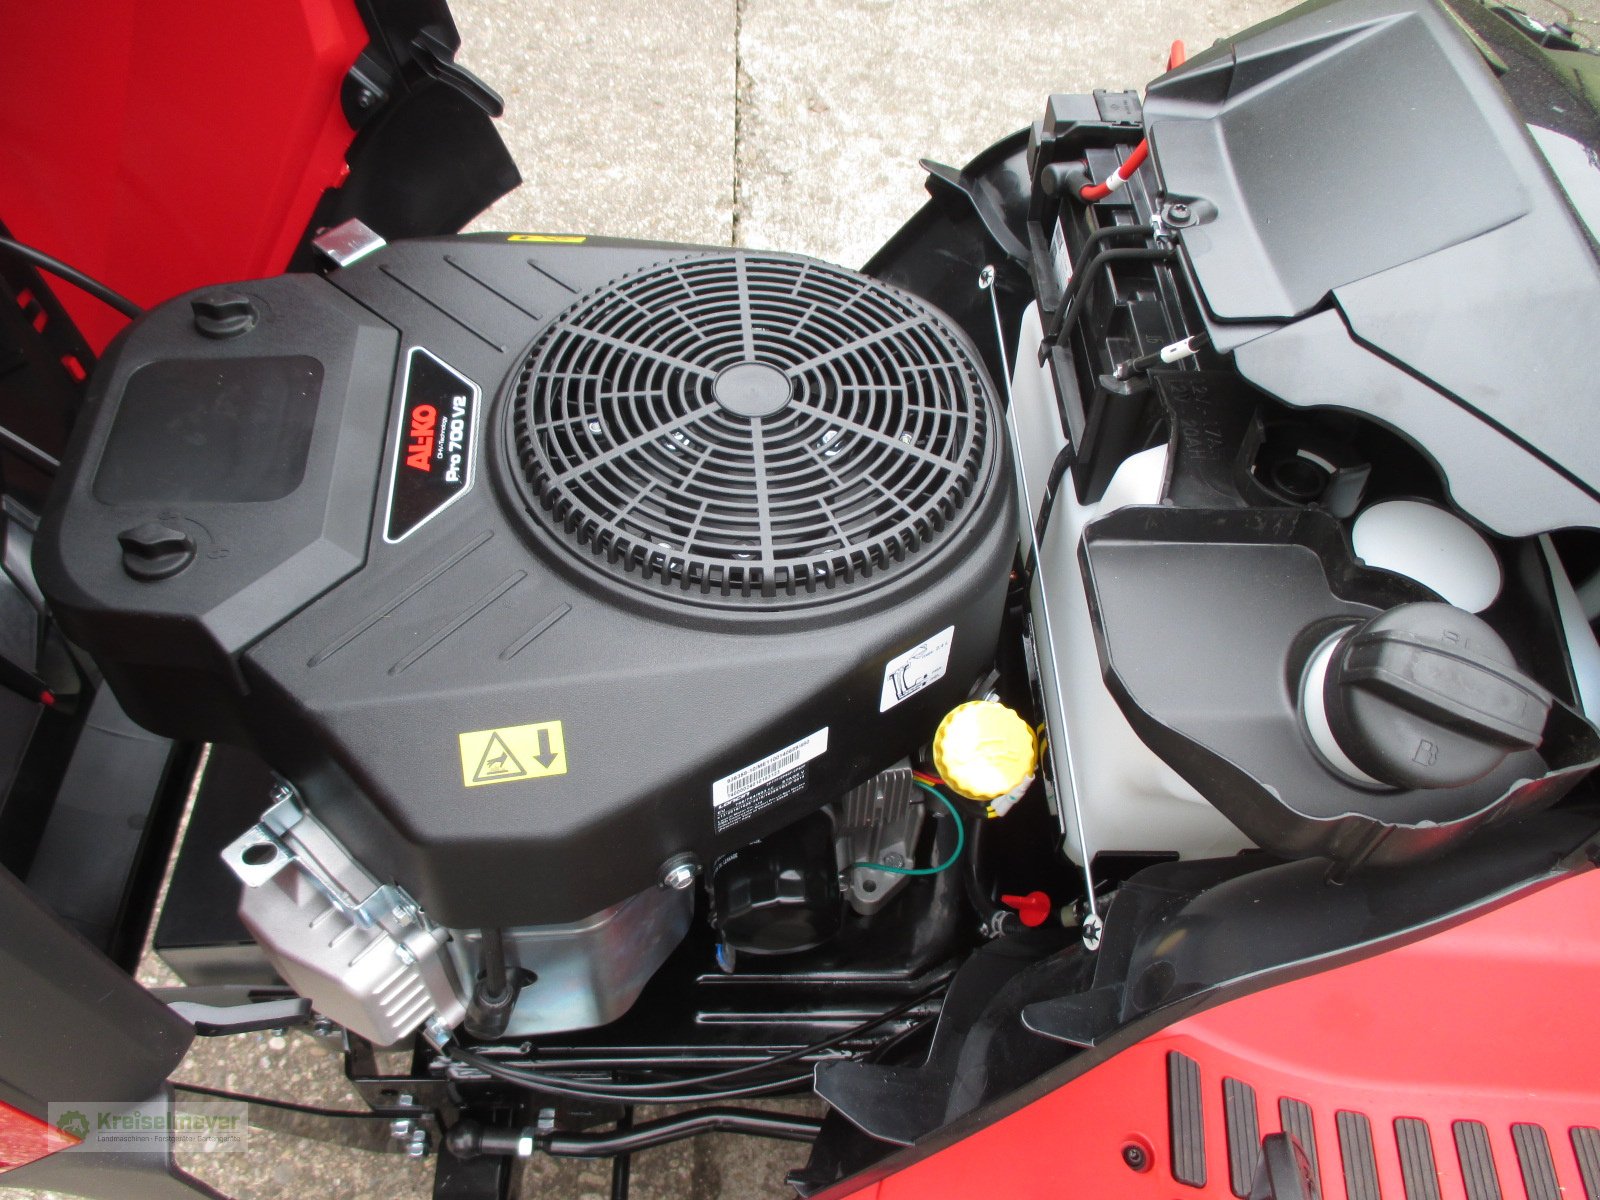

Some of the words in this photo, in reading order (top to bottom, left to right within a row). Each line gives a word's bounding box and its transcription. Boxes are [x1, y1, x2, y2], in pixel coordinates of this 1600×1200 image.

[452, 395, 467, 418] V2
[406, 404, 437, 472] AL-KO
[448, 418, 465, 451] 700
[445, 453, 462, 482] Pro
